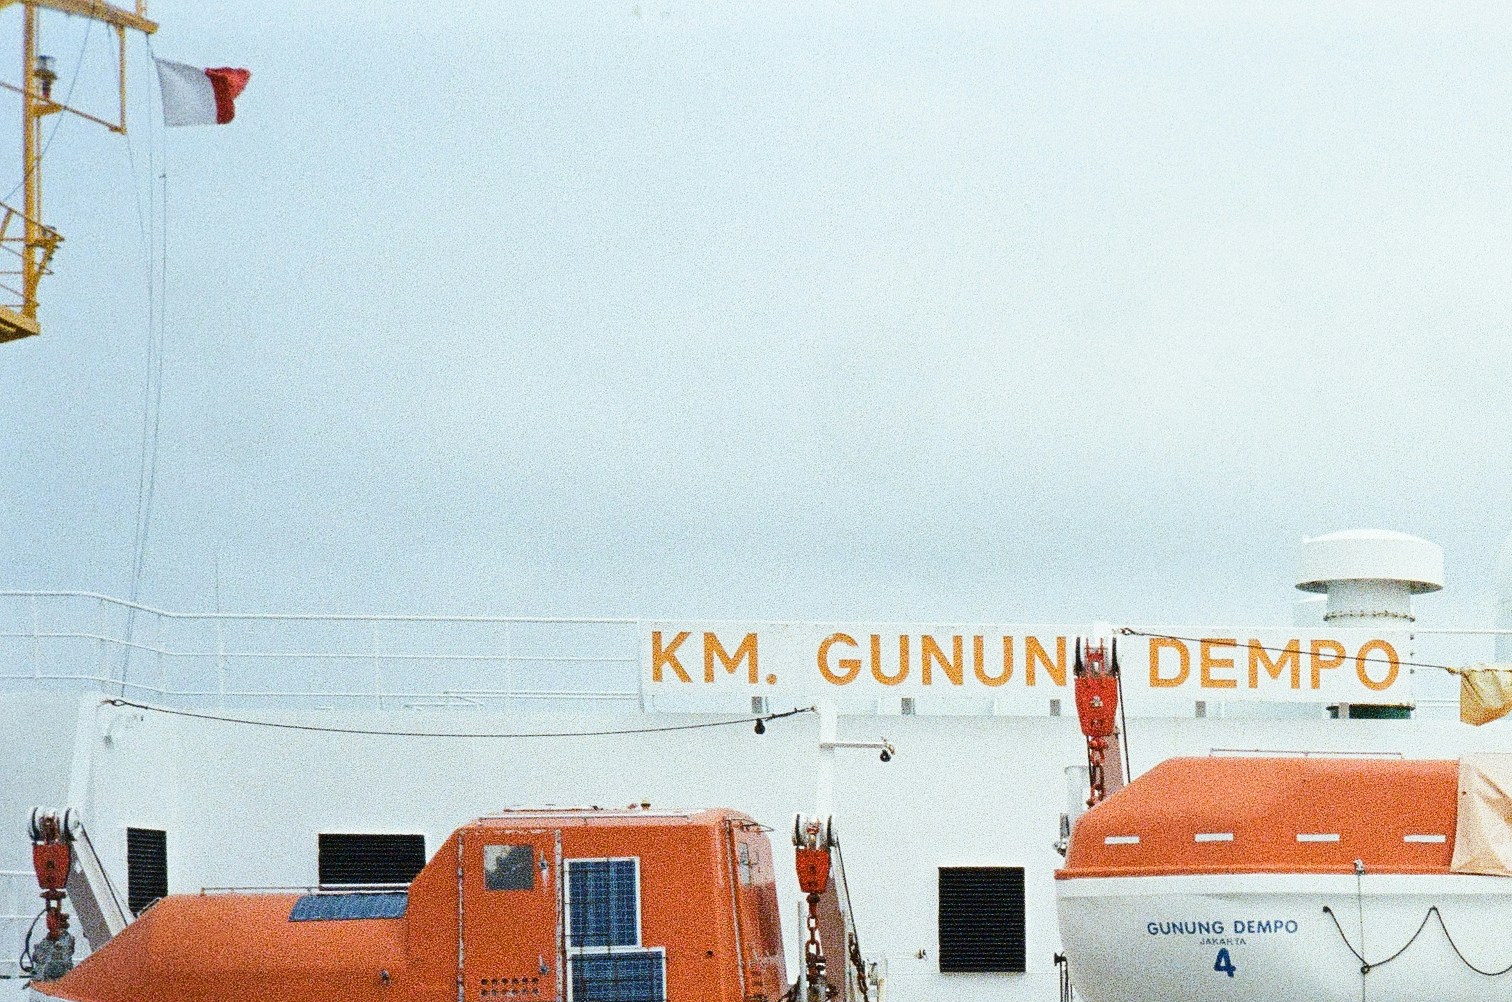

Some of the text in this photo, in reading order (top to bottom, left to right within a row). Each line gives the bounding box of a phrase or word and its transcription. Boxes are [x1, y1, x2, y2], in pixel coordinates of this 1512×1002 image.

[651, 630, 1400, 692] KM. GUNUN DEMPO
[1147, 919, 1298, 935] GUNUNG DEMPO
[1200, 937, 1247, 946] JAKARTA
[1213, 947, 1236, 978] 4
